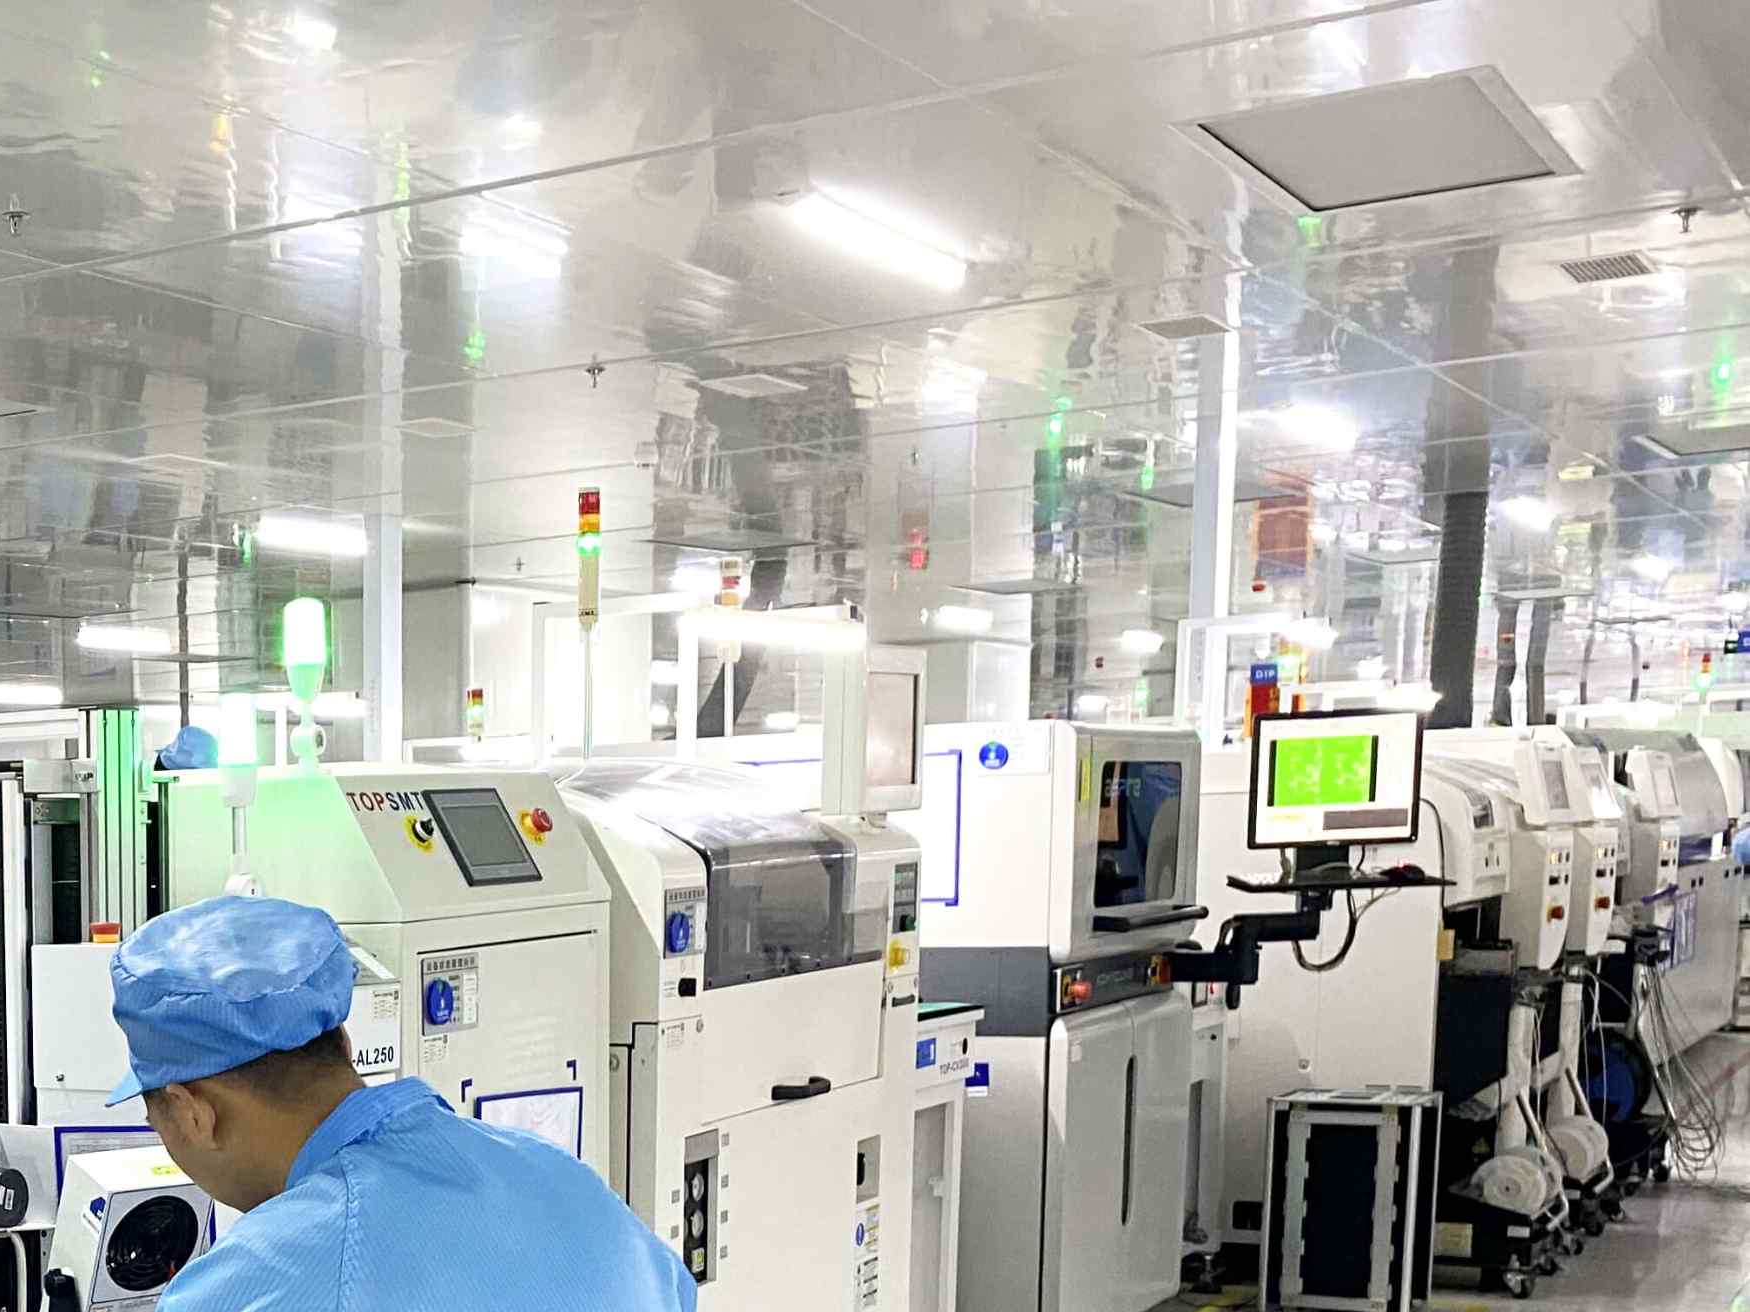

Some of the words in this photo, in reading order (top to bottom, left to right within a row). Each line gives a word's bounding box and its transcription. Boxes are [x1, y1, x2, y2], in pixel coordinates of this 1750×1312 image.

[1255, 669, 1276, 680] DIP
[346, 791, 425, 812] TOPSMT
[352, 1045, 395, 1067] -AL250
